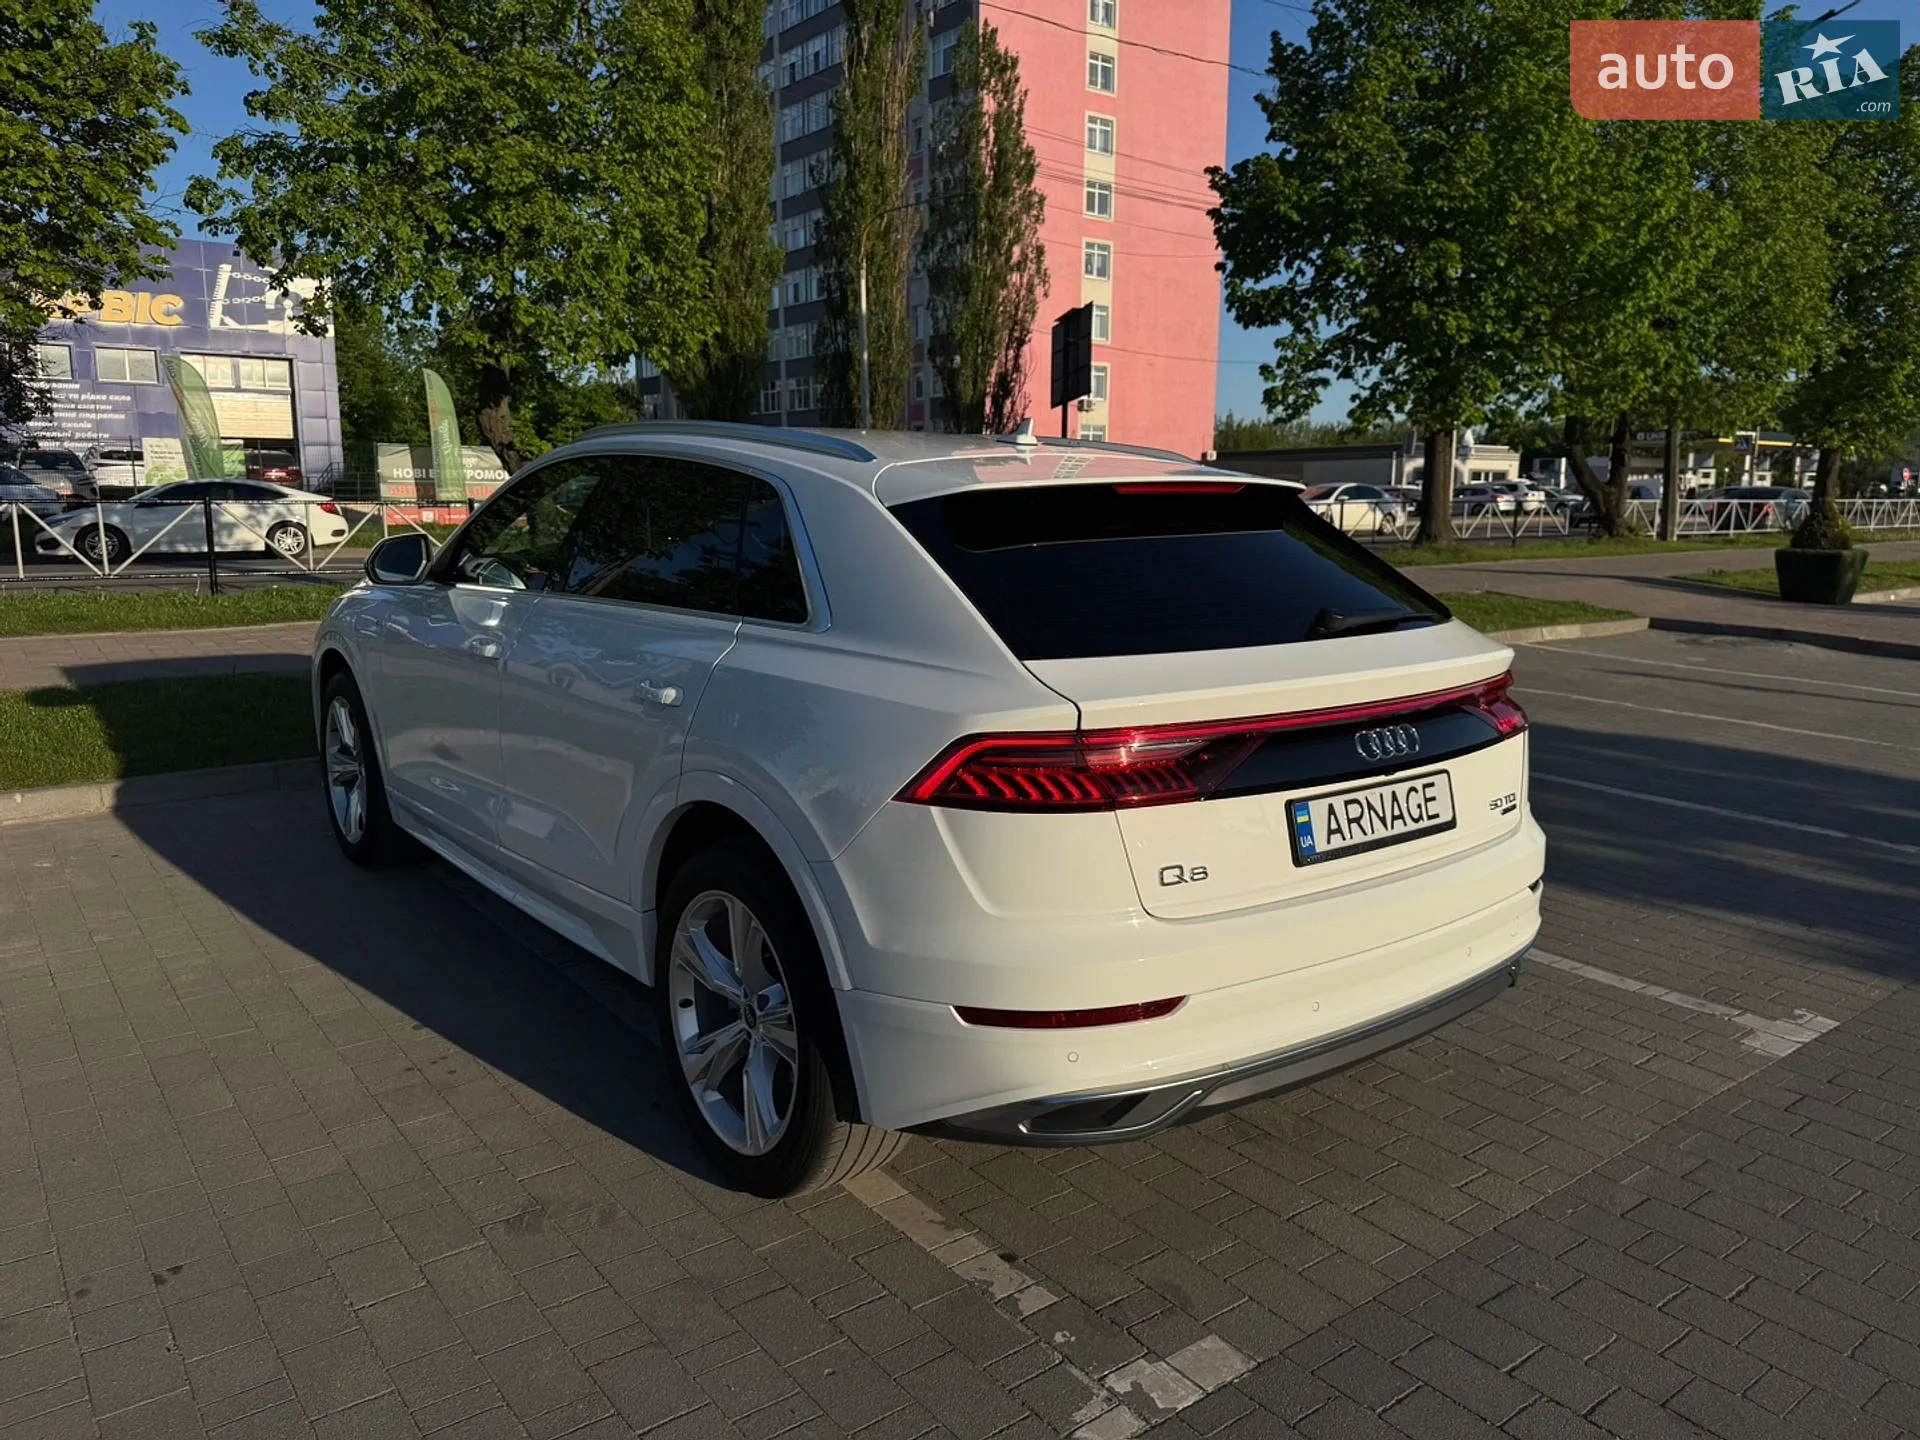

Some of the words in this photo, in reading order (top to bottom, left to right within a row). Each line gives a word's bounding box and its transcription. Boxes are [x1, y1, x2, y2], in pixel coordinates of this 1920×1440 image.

[393, 468, 427, 479] НОВІ
[1326, 781, 1440, 845] ARNAGE
[1301, 836, 1314, 848] UA
[1159, 864, 1209, 887] Q8
